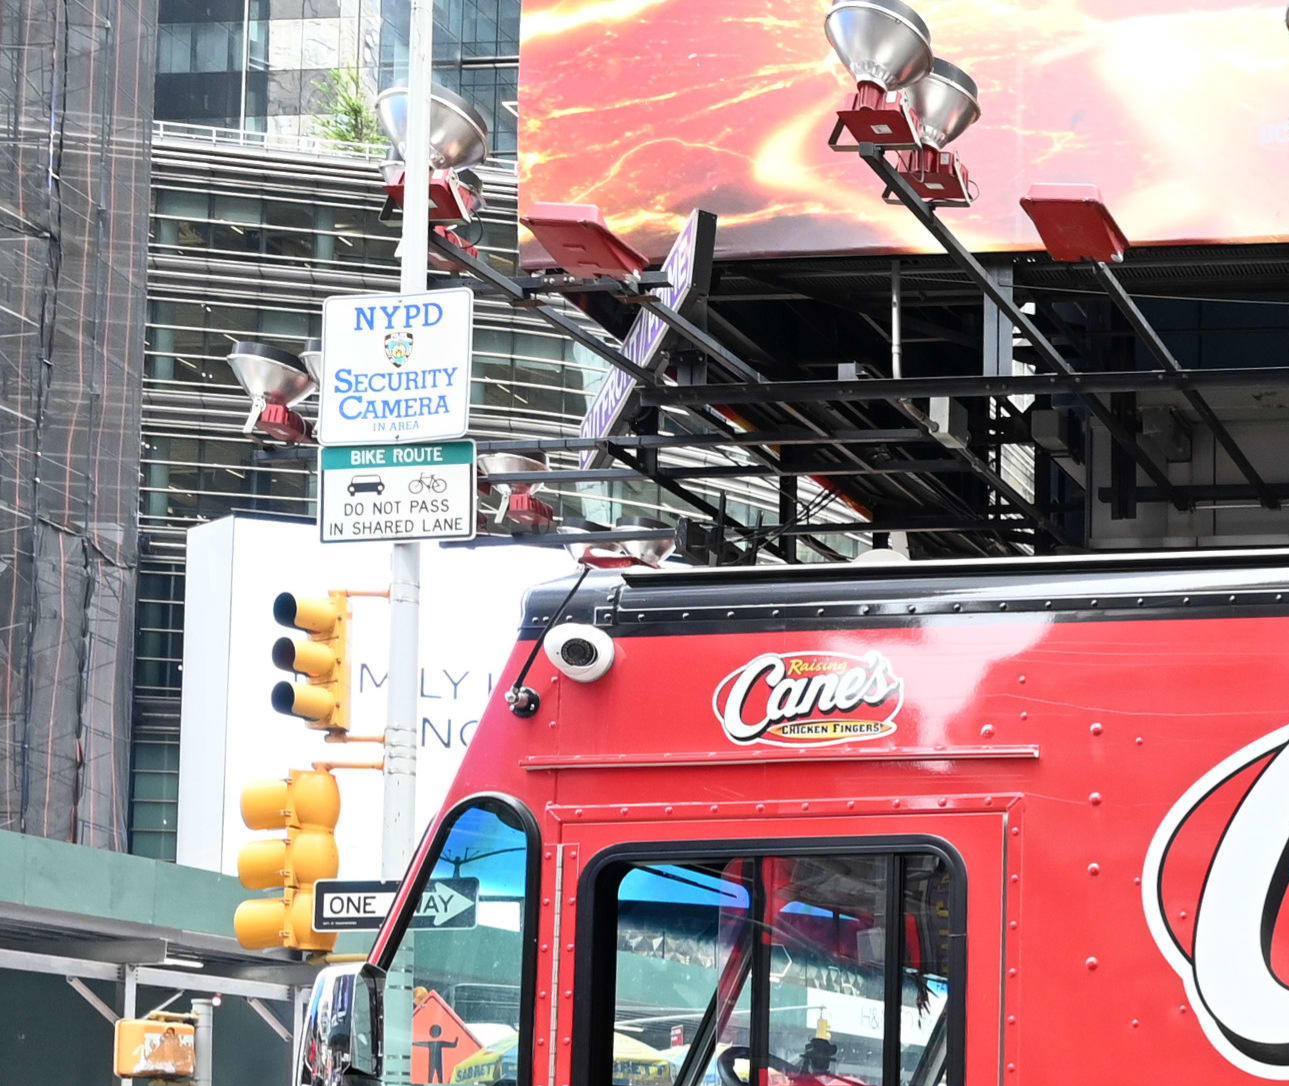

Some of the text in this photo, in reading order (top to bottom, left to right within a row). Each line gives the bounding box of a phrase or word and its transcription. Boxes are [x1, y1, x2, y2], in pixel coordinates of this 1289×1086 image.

[354, 302, 443, 331] NYPD
[334, 367, 457, 394] SECURITY
[339, 395, 450, 420] CAMERA
[373, 420, 420, 432] IN AREA
[350, 447, 443, 465] BIKE ROUTE
[344, 499, 450, 516] DO NOT PASS
[330, 518, 463, 536] IN SHARED LANE
[788, 658, 848, 675] Raising
[724, 651, 898, 741] Cane's
[782, 723, 881, 735] CHICKEN FINGERS
[329, 896, 376, 915] ONE
